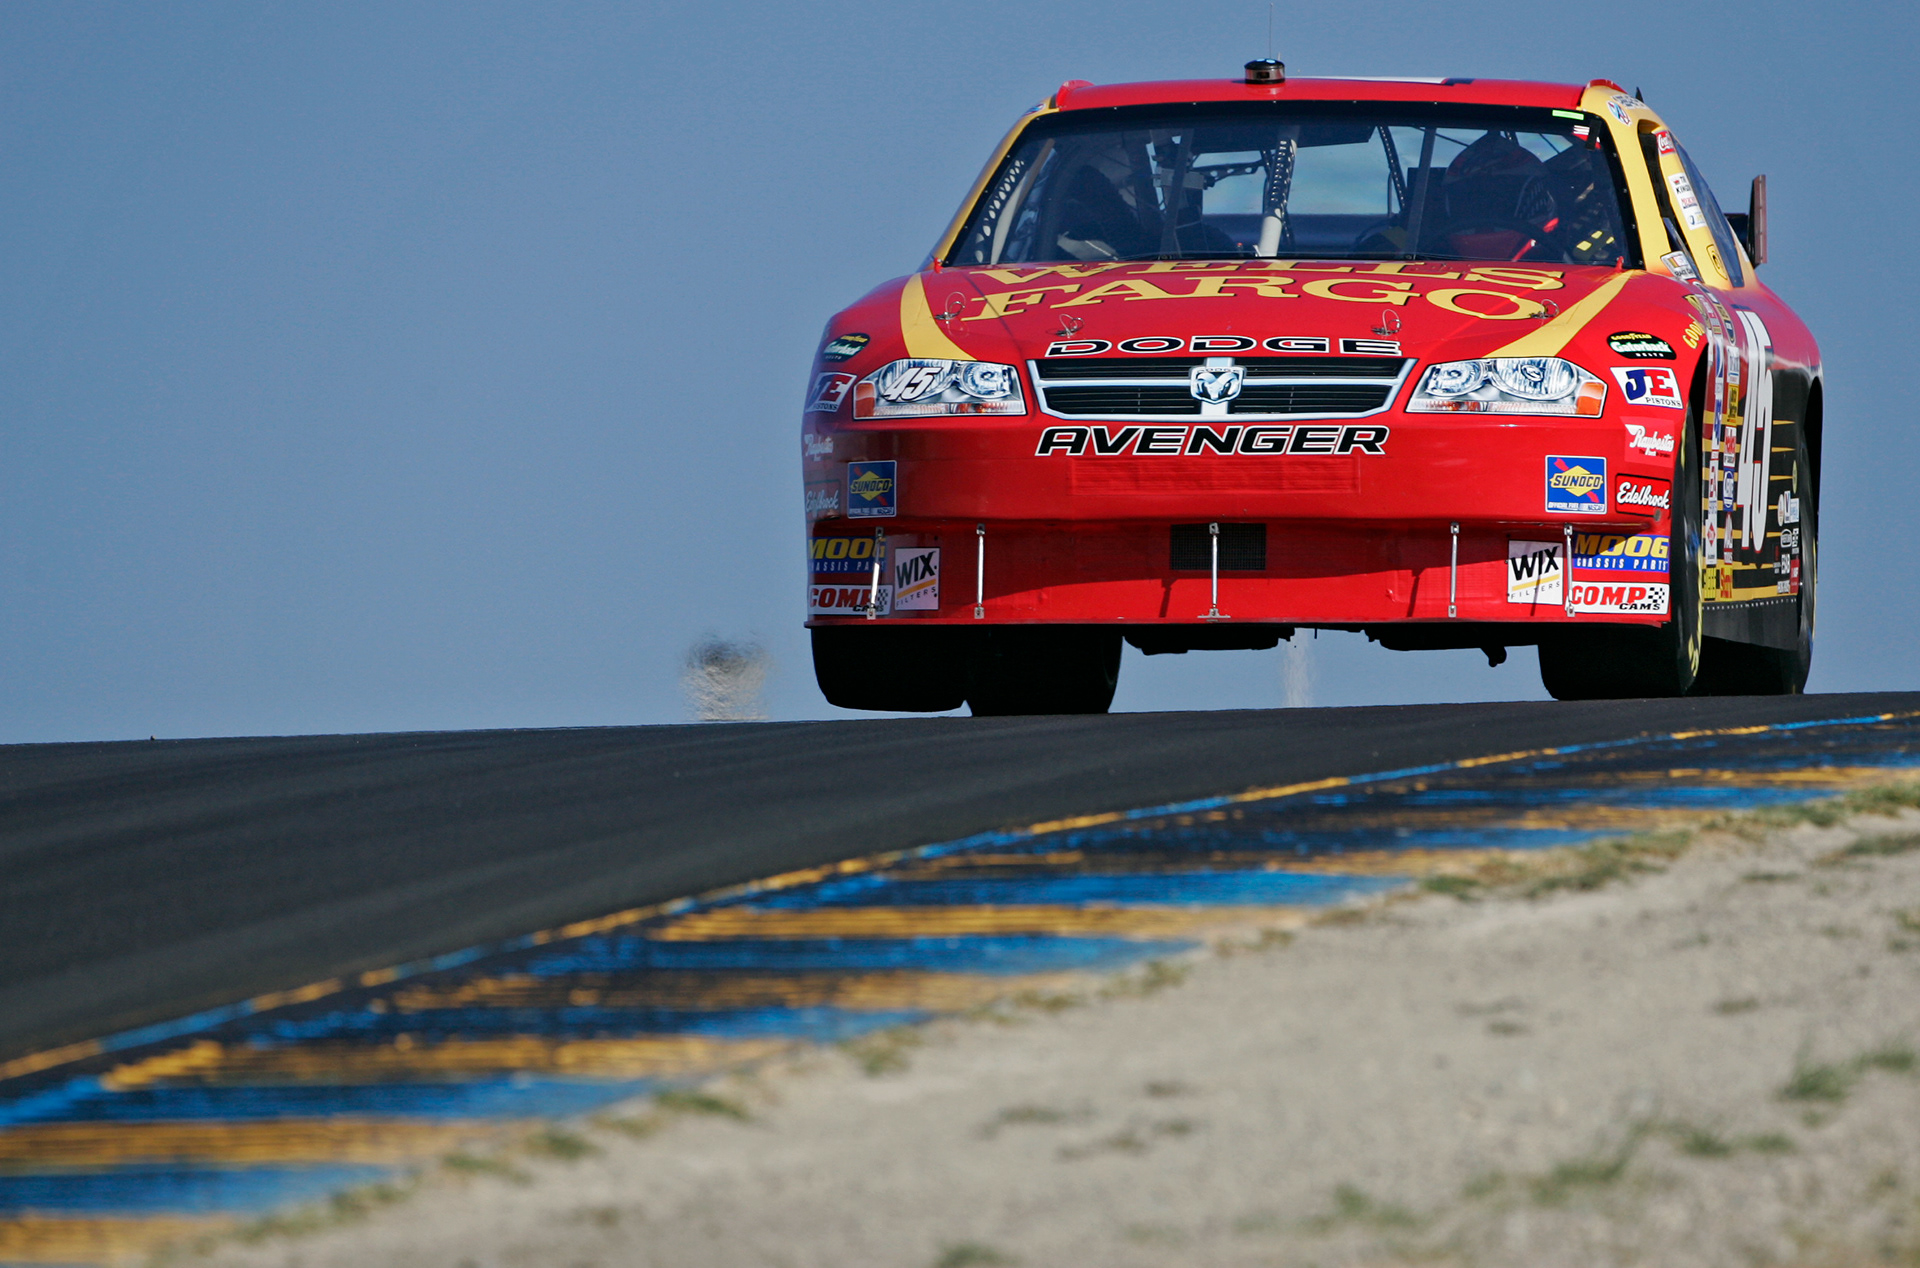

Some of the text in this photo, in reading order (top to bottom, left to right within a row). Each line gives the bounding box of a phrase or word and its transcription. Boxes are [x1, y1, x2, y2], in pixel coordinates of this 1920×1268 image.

[960, 276, 1546, 321] FARGO
[1044, 335, 1402, 358] DODGE
[881, 367, 944, 402] 45
[1625, 369, 1674, 400] JE
[1645, 397, 1682, 407] PISTONS
[1034, 425, 1391, 456] AVENGER
[851, 480, 890, 493] SUNOCO
[1553, 475, 1602, 488] SUNOCO
[1616, 482, 1670, 509] Edelbrock
[1574, 534, 1669, 558] MOOG
[896, 551, 937, 588] WIX
[1510, 546, 1561, 581] WIX
[1576, 558, 1669, 571] CHASSIS PARTS
[896, 587, 937, 607] FILTERS
[1510, 580, 1561, 600] FILTERS
[1572, 585, 1647, 606] COMP
[1619, 603, 1661, 611] CAMS
